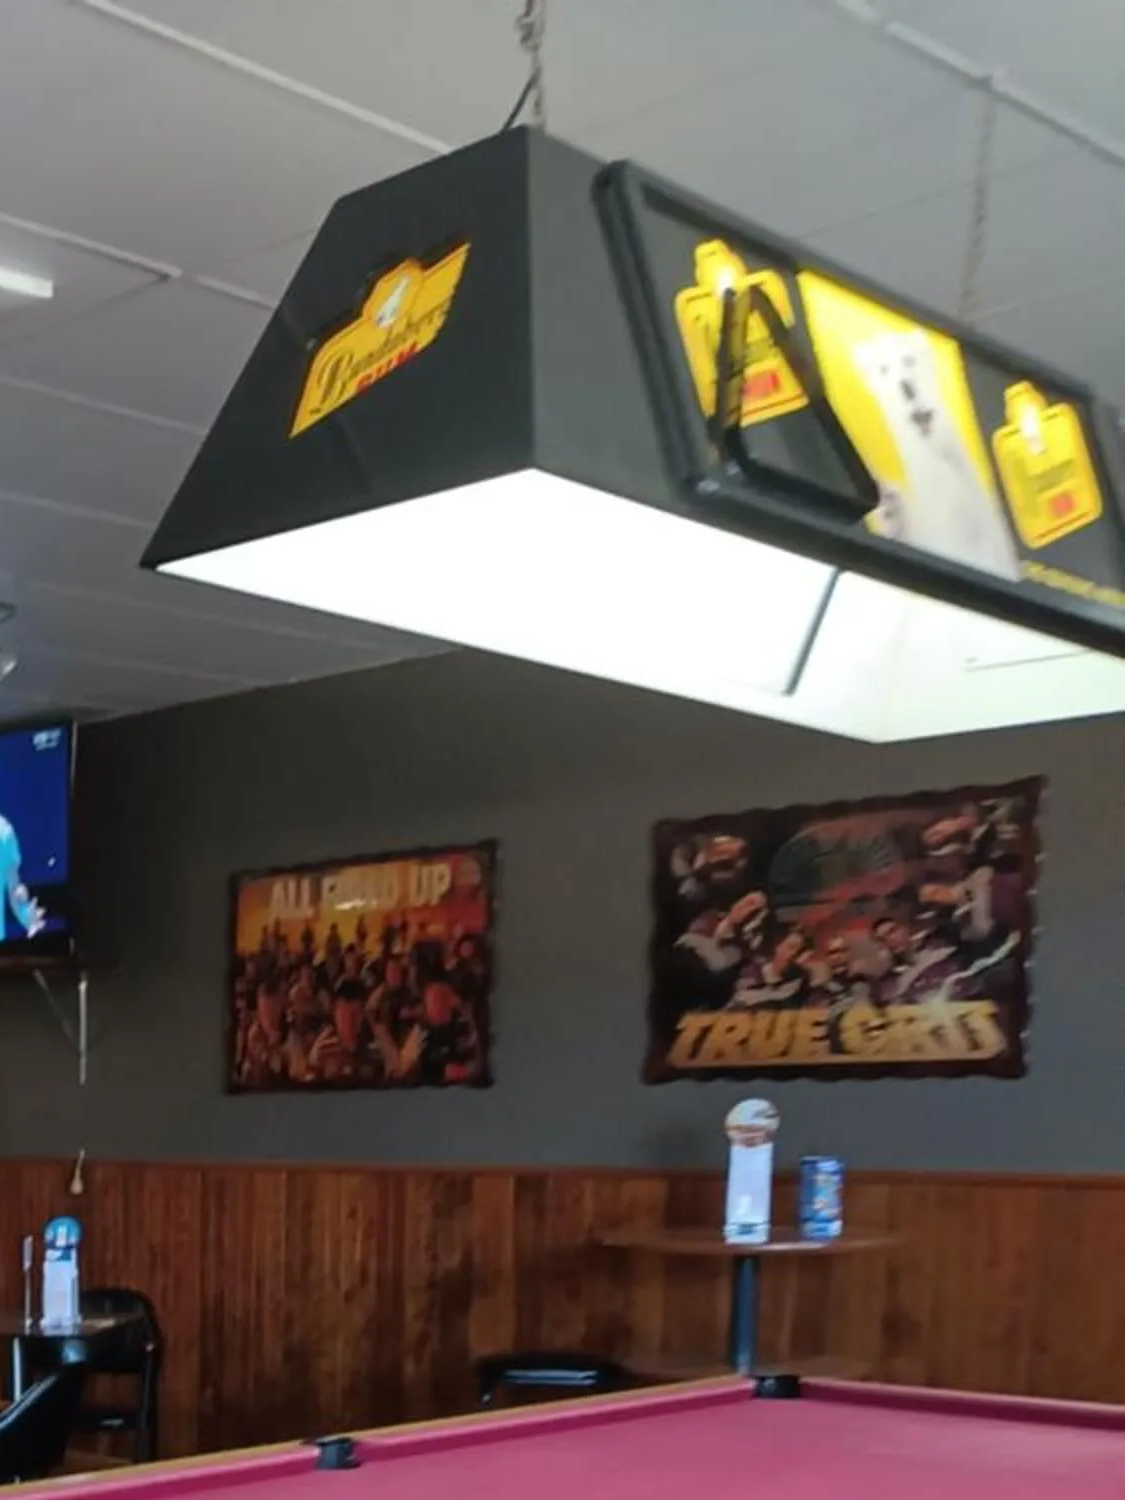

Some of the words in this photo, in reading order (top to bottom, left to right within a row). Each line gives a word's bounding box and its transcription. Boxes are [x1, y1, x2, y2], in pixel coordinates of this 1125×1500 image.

[270, 877, 316, 919] ALL
[410, 862, 452, 908] UP
[672, 1009, 830, 1064] TRUE
